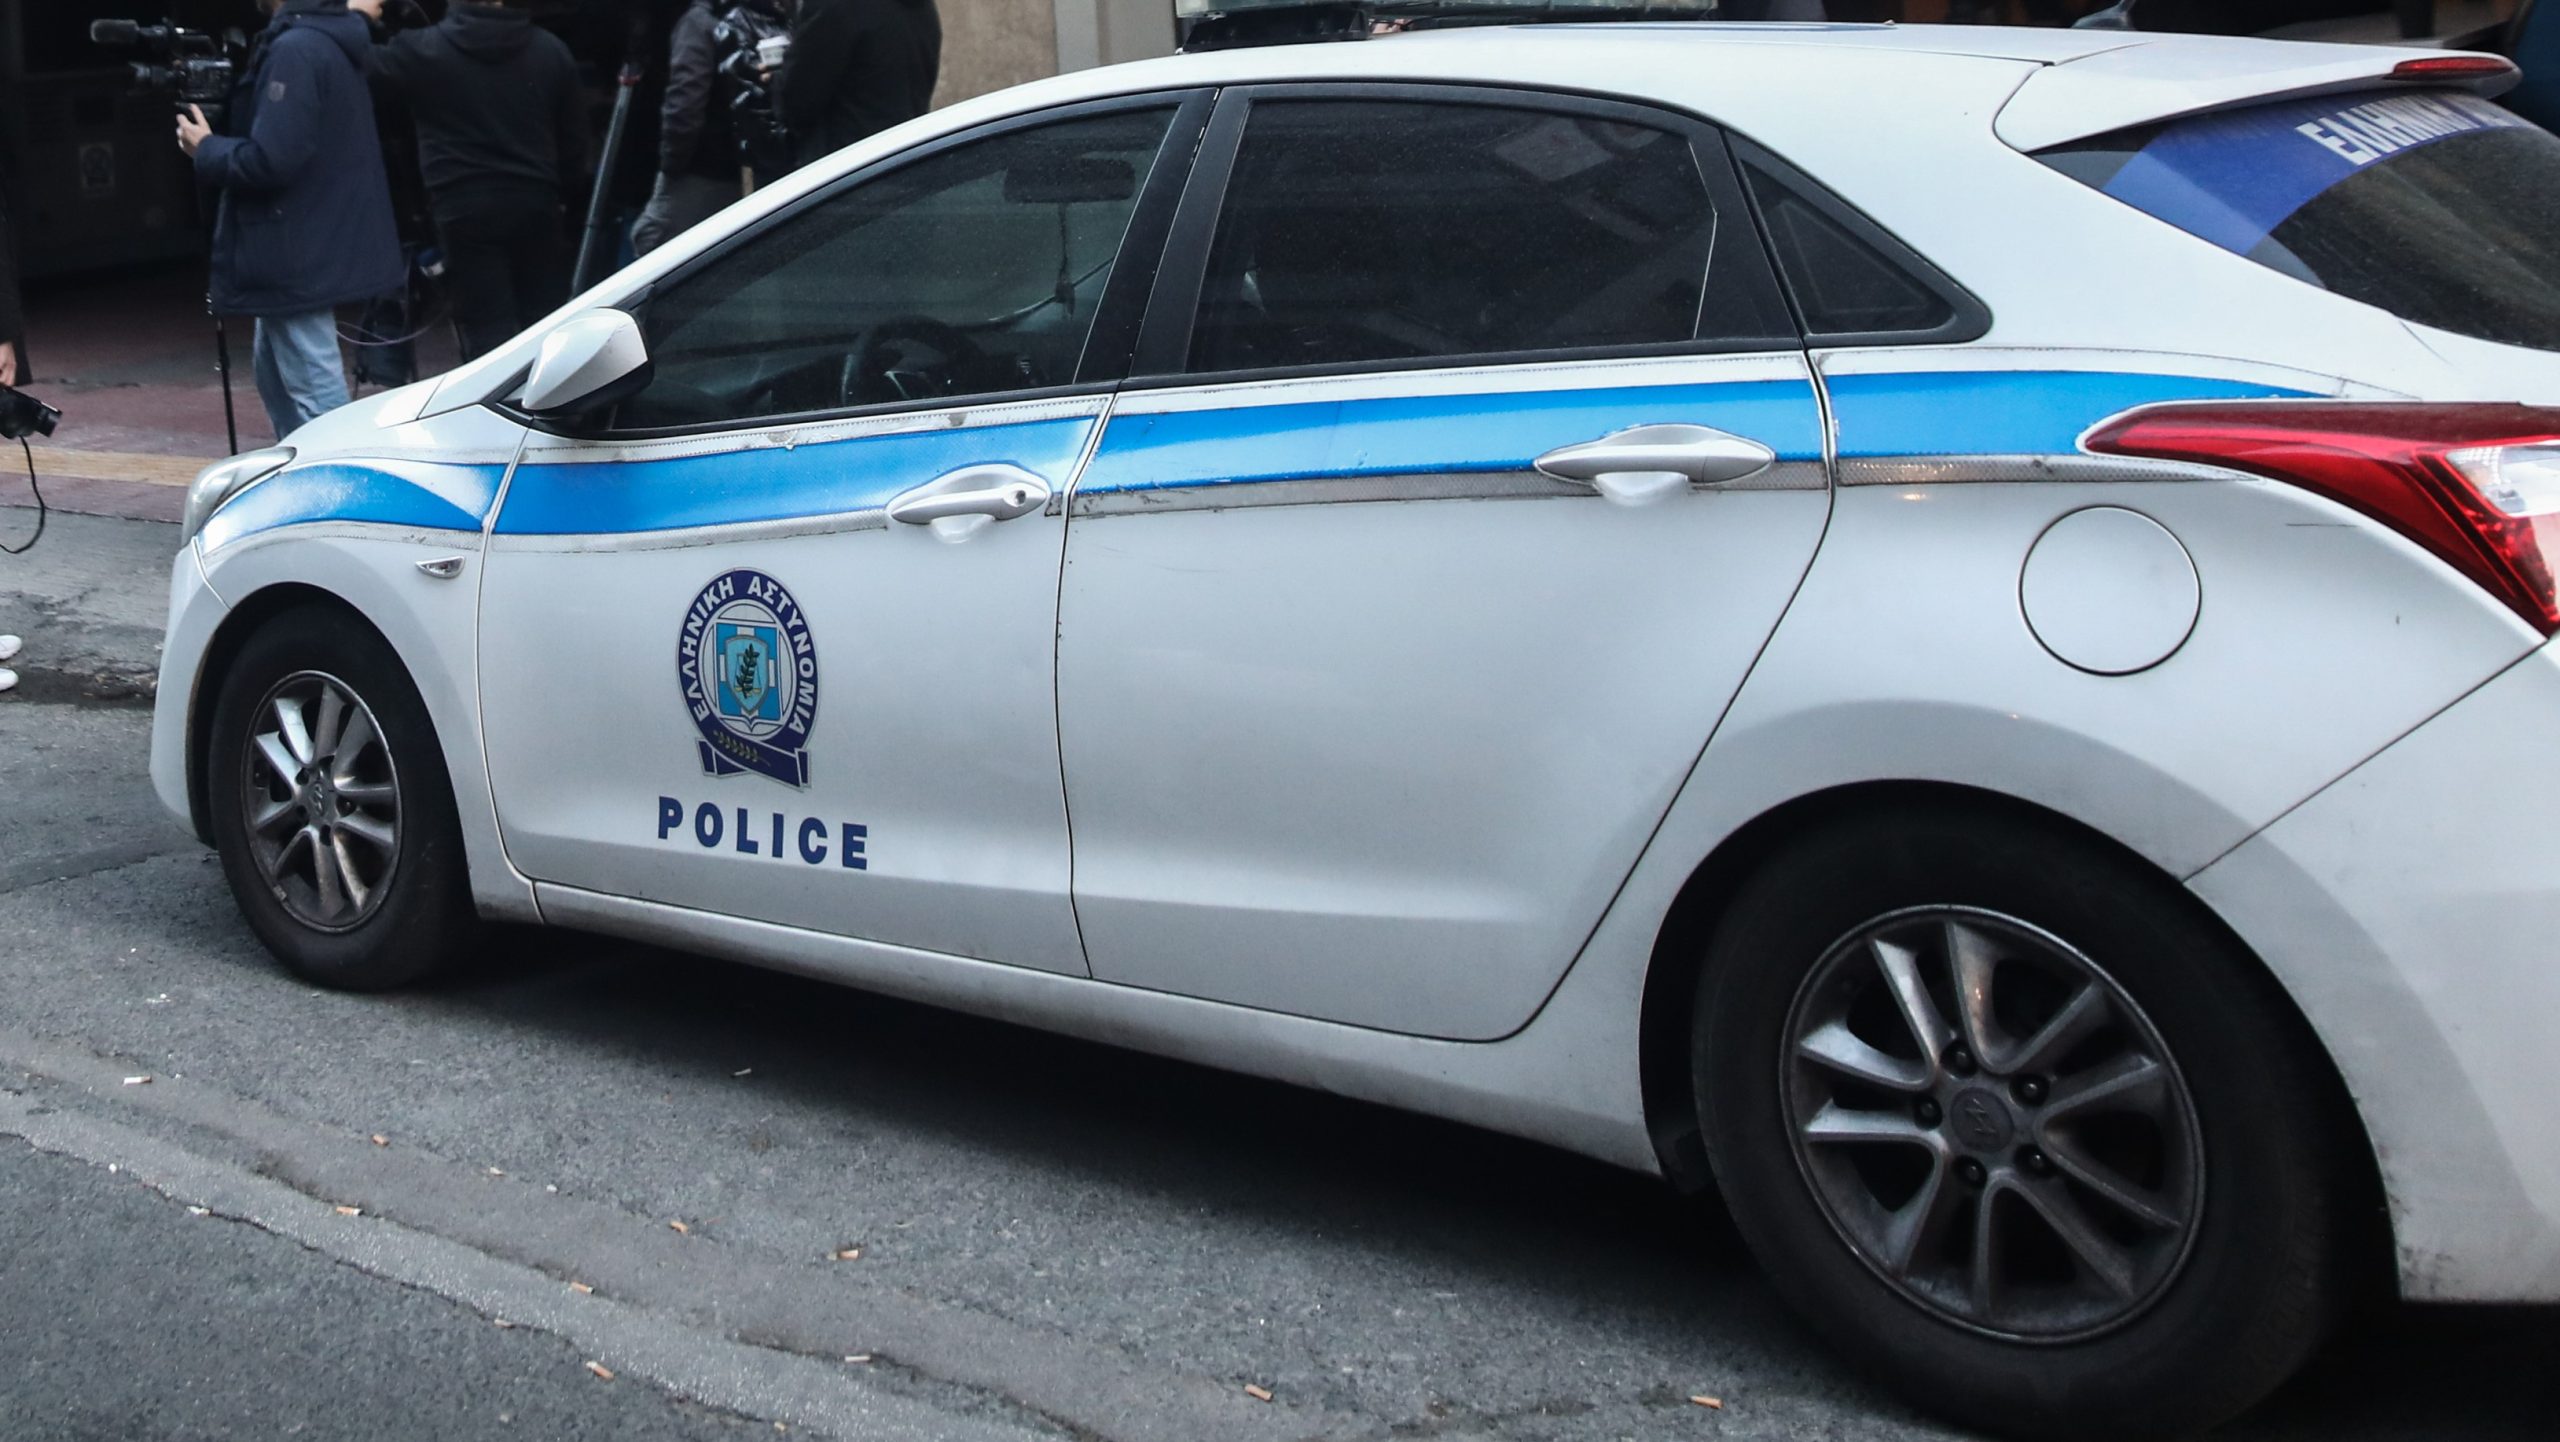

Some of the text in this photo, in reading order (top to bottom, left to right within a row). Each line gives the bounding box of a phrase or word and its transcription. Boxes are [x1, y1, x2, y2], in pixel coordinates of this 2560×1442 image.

[682, 576, 814, 735] ΕΛΛΗΝΙΚΗ ΑΣΤΥΝΟΜΙΑ
[658, 796, 867, 870] POLICE
